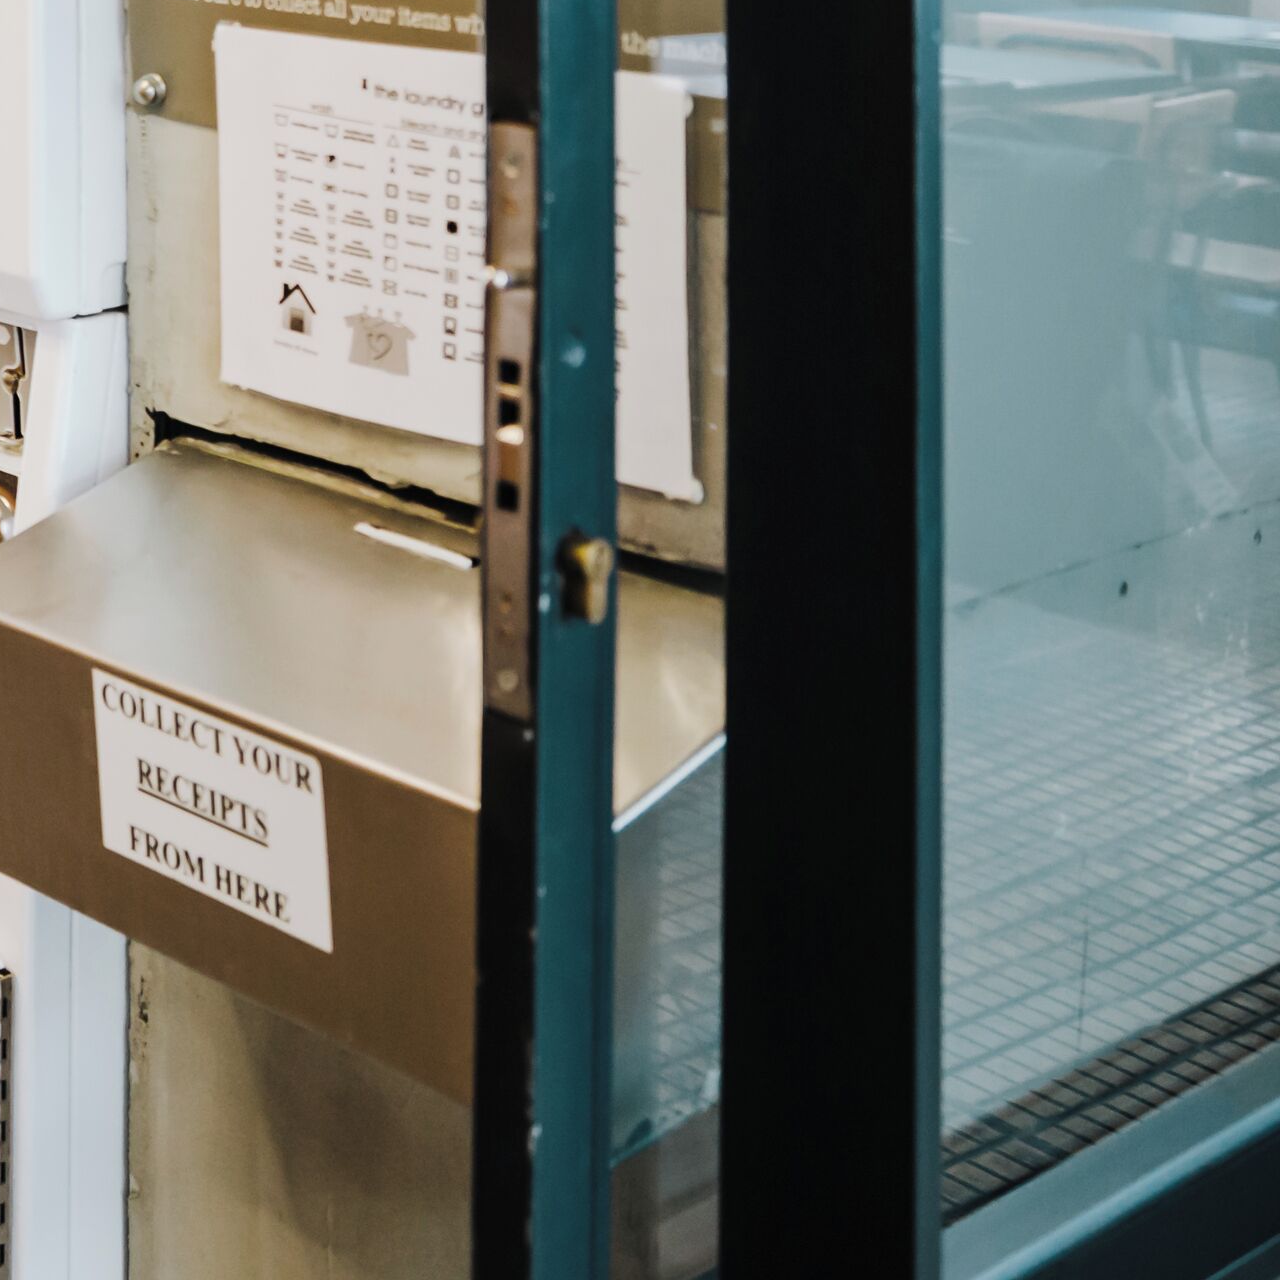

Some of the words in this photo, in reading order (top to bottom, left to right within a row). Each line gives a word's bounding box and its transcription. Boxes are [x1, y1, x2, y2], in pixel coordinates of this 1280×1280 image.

[349, 2, 396, 25] your
[397, 6, 451, 31] items
[102, 682, 224, 757] COLLECT
[233, 735, 313, 794] YOUR
[136, 757, 269, 841] RECEIPTS
[130, 824, 204, 883] FROM
[214, 864, 291, 922] HERE
